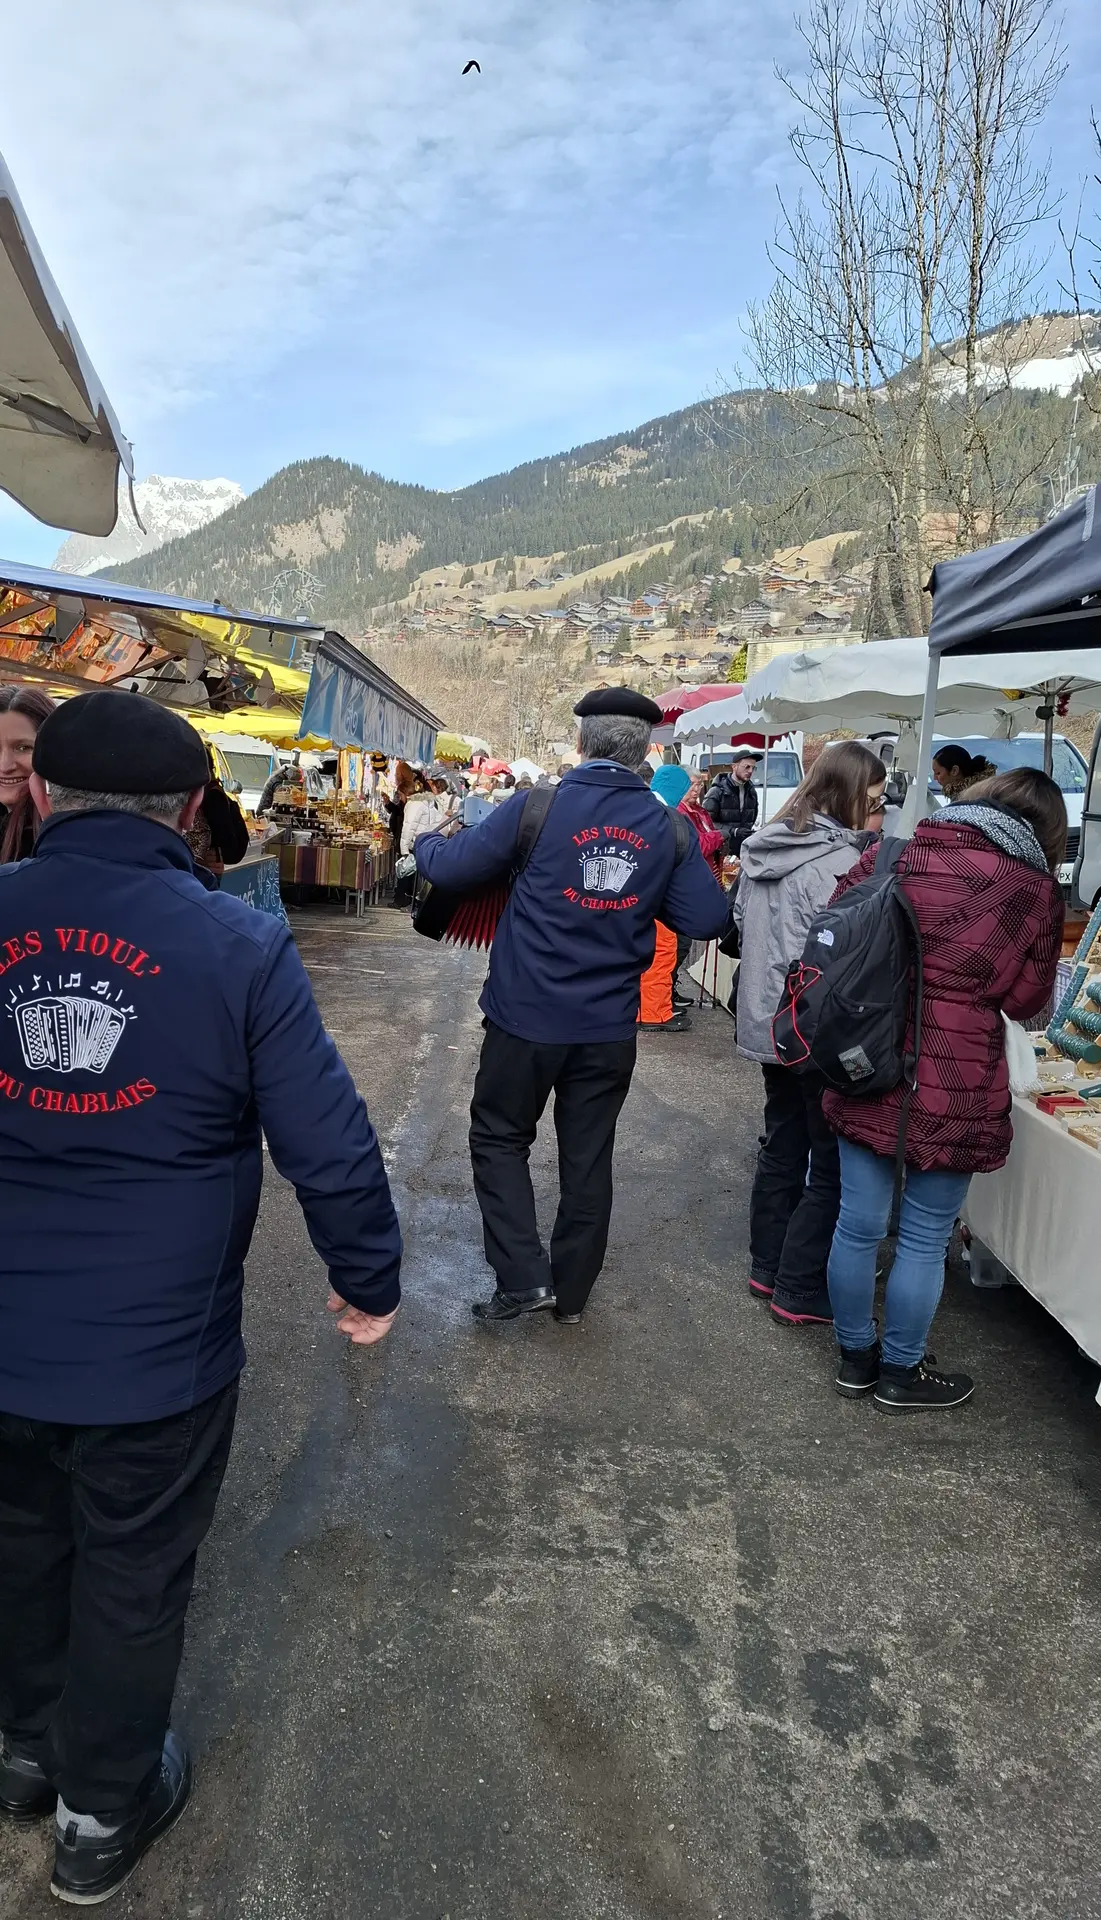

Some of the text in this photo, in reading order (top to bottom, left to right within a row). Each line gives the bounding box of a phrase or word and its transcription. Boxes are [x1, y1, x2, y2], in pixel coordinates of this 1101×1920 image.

[573, 826, 650, 849] LES VIOUL'
[563, 887, 639, 910] DU CHABLAIS
[55, 928, 161, 977] VIOUL'
[28, 1077, 157, 1114] CHABLAIS
